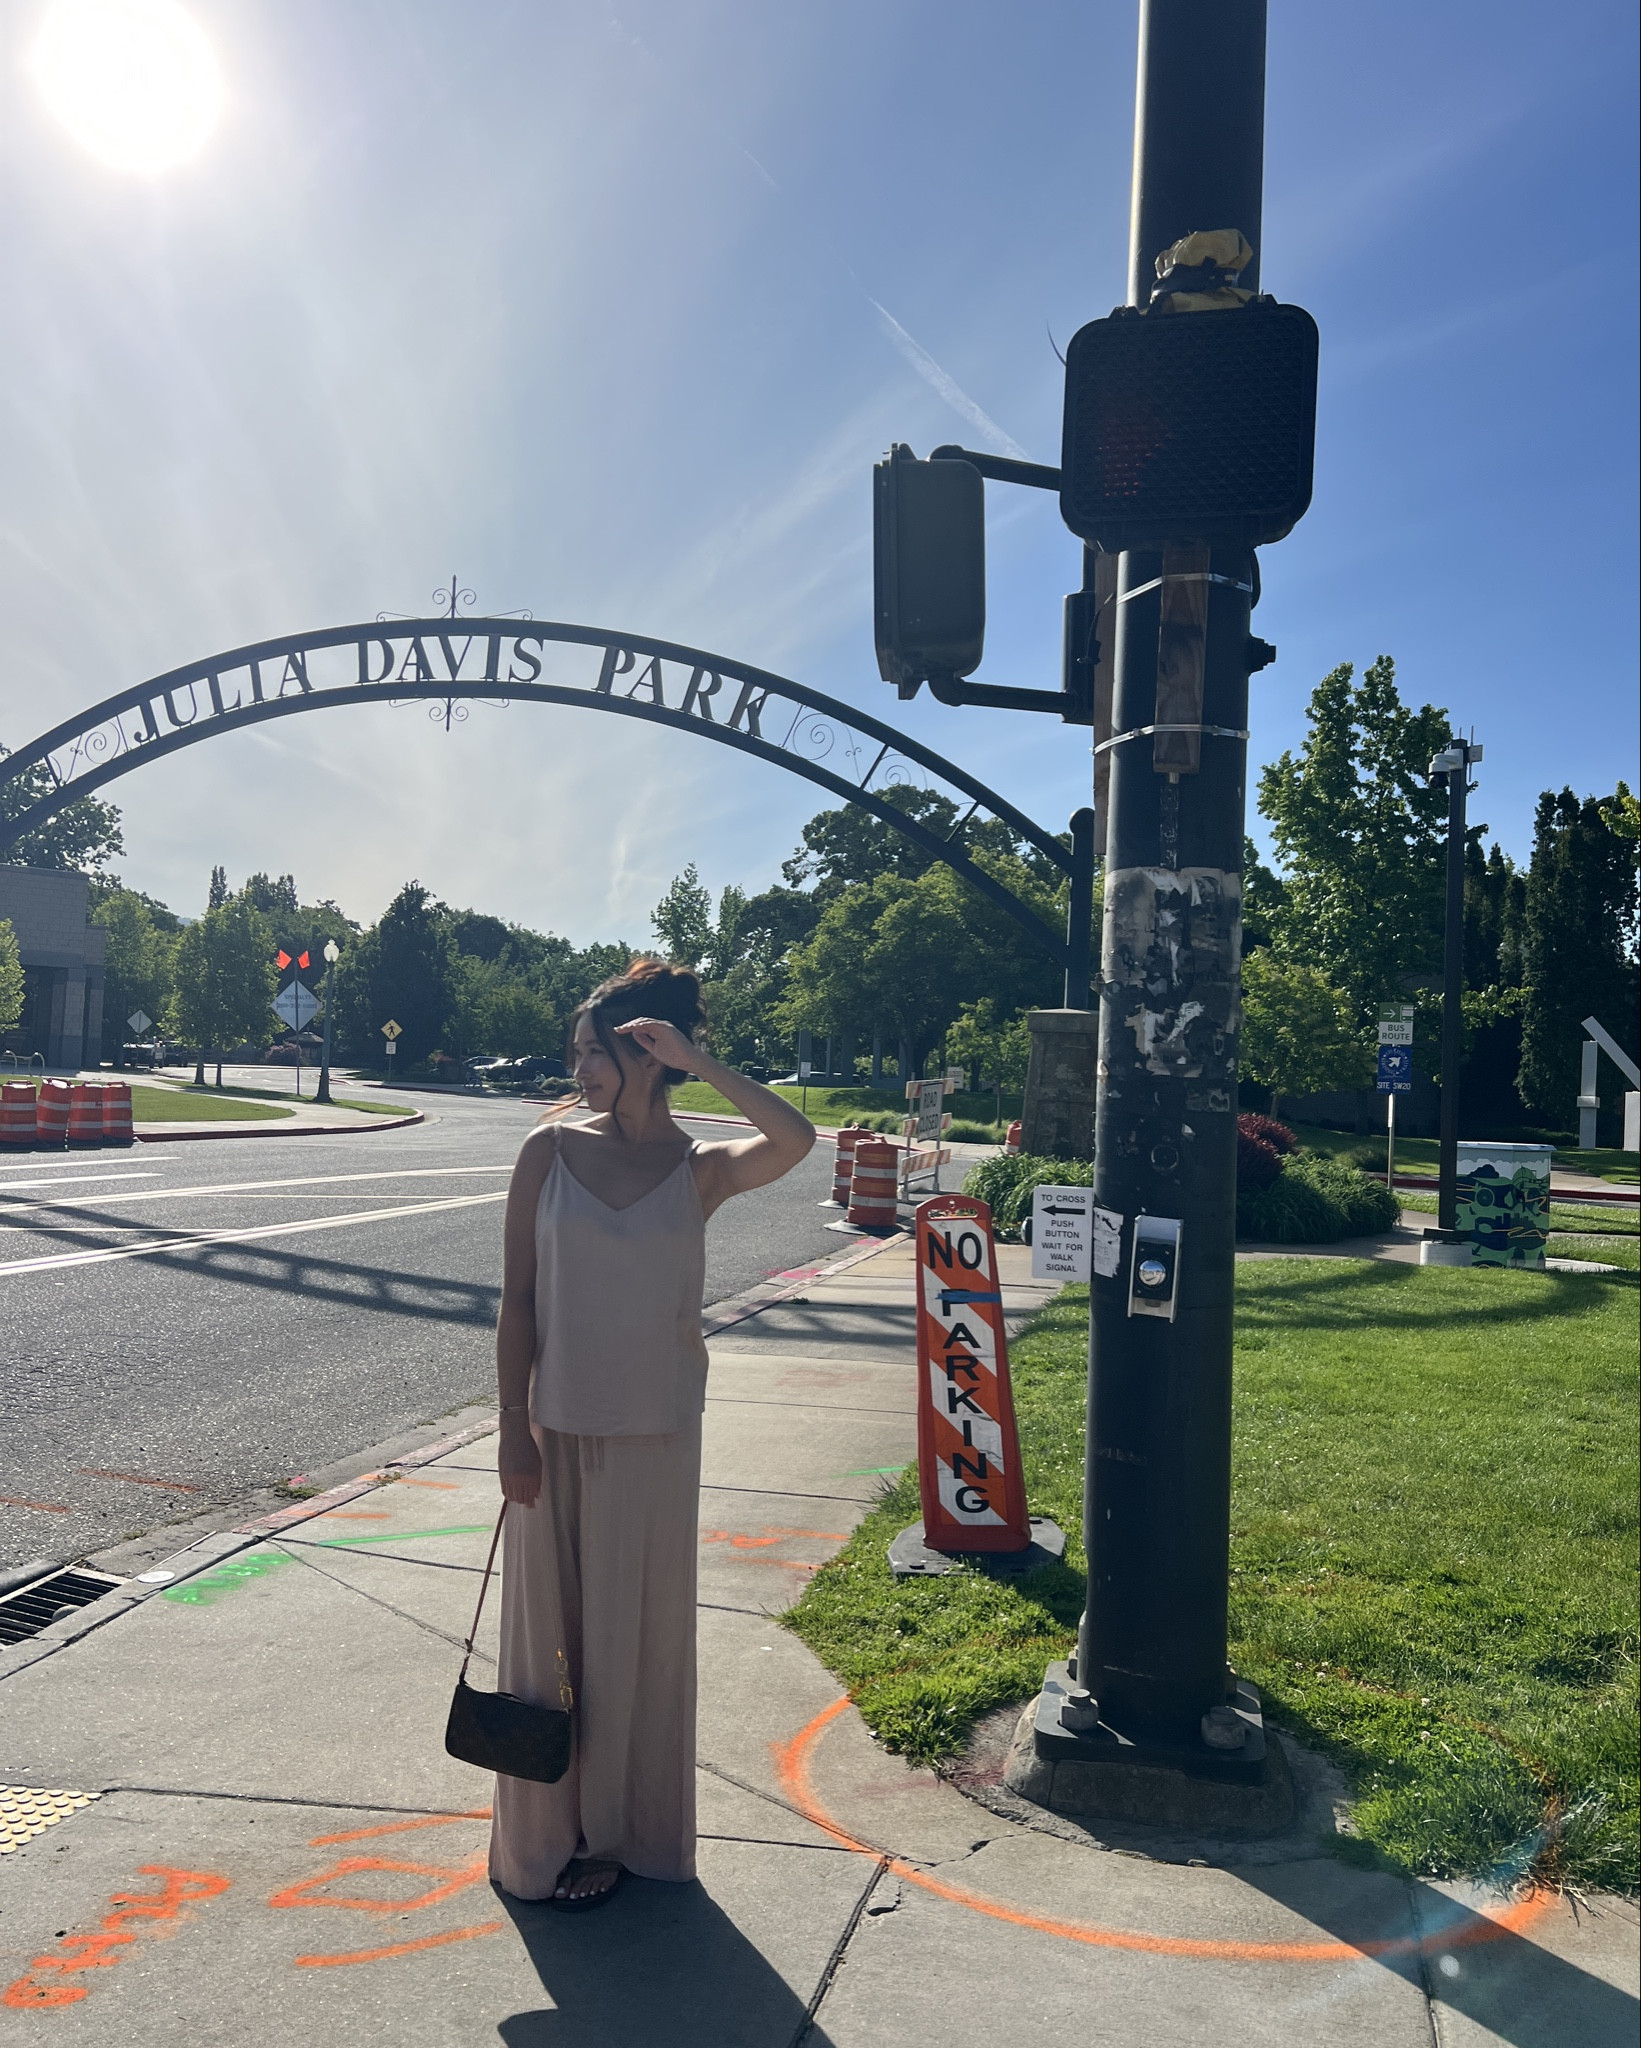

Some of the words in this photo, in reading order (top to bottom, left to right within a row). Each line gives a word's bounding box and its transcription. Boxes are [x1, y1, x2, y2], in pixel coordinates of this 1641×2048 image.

[133, 648, 316, 745] JULIA
[354, 636, 545, 685] DAVIS
[590, 646, 777, 740] PARK
[1387, 1024, 1405, 1032] BUS
[1381, 1032, 1411, 1041] ROUTE
[1376, 1081, 1390, 1090] SITE
[923, 1091, 938, 1109] ROAD
[919, 1113, 939, 1133] CLOSED
[1041, 1194, 1053, 1202] TO
[1056, 1195, 1086, 1203] CROSS
[1050, 1219, 1074, 1228] PUSH
[1044, 1229, 1080, 1239] BUTTON
[926, 1231, 983, 1271] NO
[1041, 1242, 1062, 1250] WAIT
[1065, 1243, 1083, 1251] FOR
[1050, 1253, 1074, 1262] WALK
[1045, 1263, 1078, 1273] SIGNAL
[941, 1288, 990, 1514] PARKING
